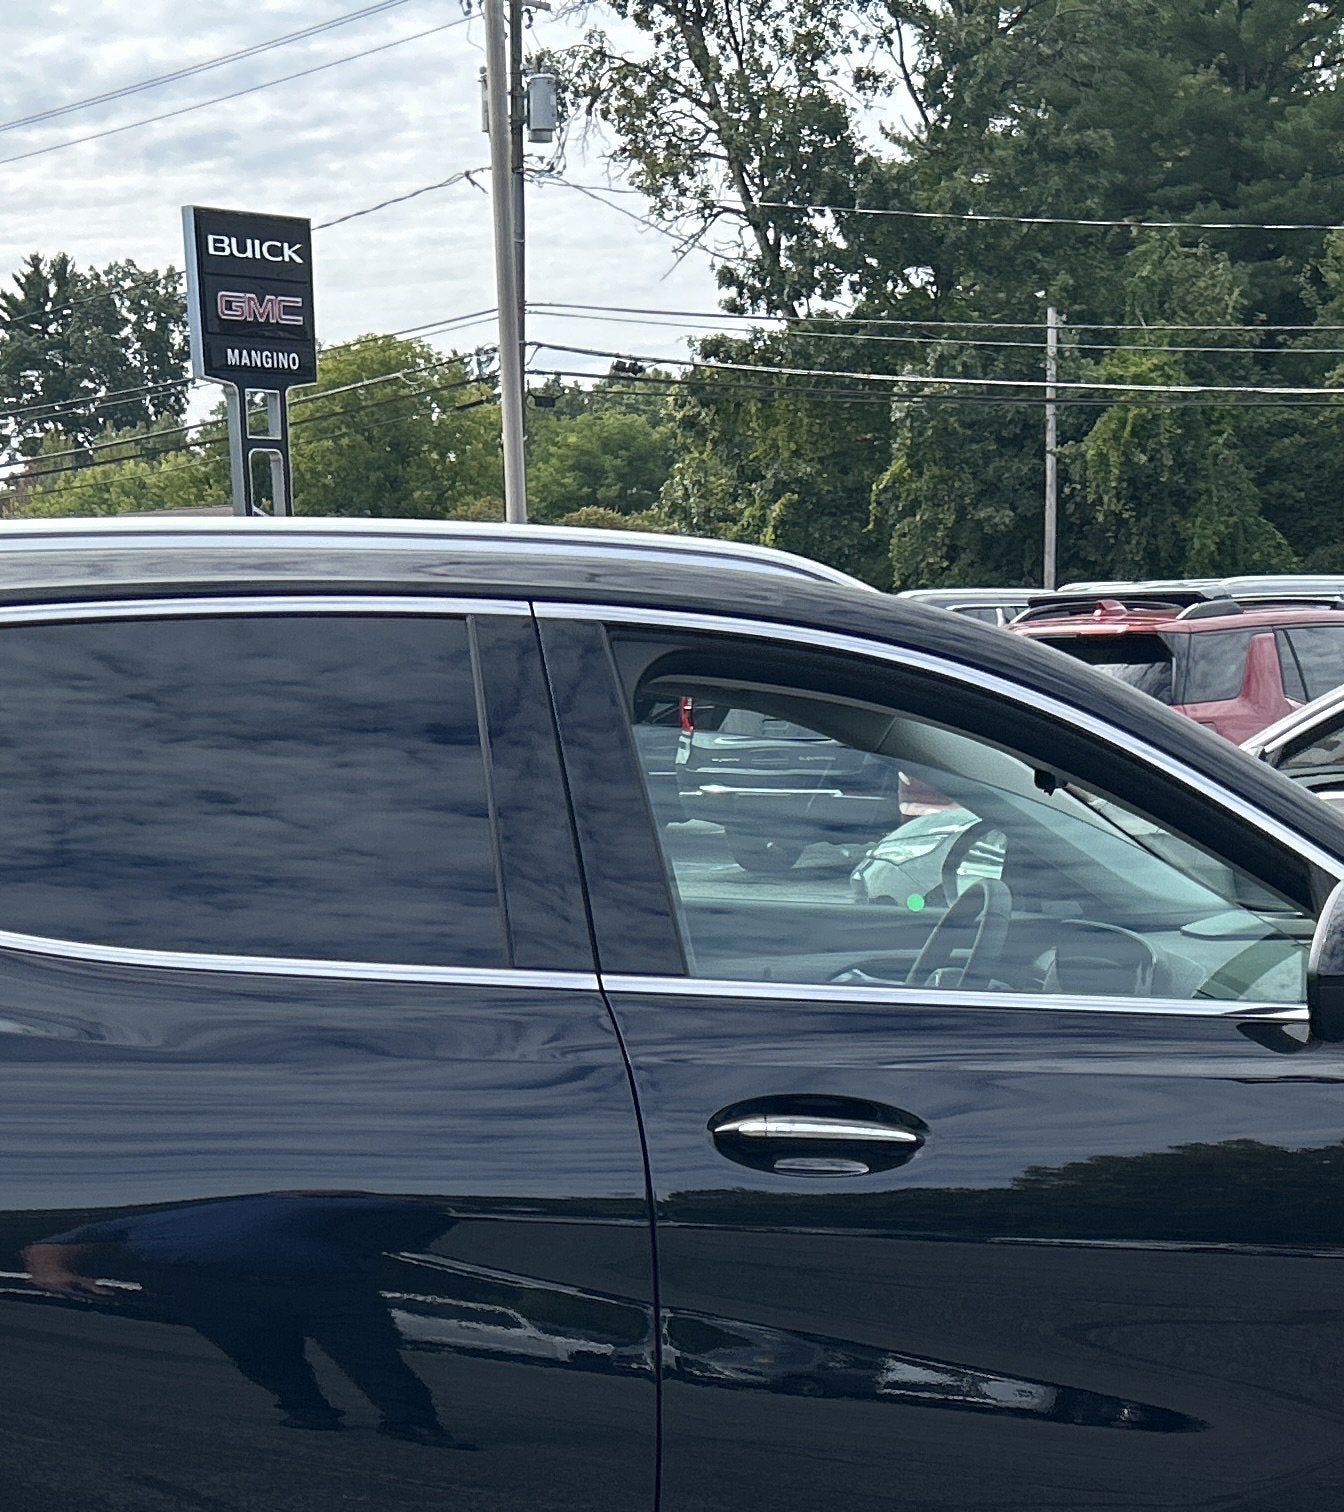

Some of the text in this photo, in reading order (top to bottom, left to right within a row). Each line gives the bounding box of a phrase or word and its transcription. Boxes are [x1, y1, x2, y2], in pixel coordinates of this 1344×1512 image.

[207, 234, 304, 264] BUICK
[217, 290, 303, 325] GMC
[227, 348, 300, 370] MANGINO
